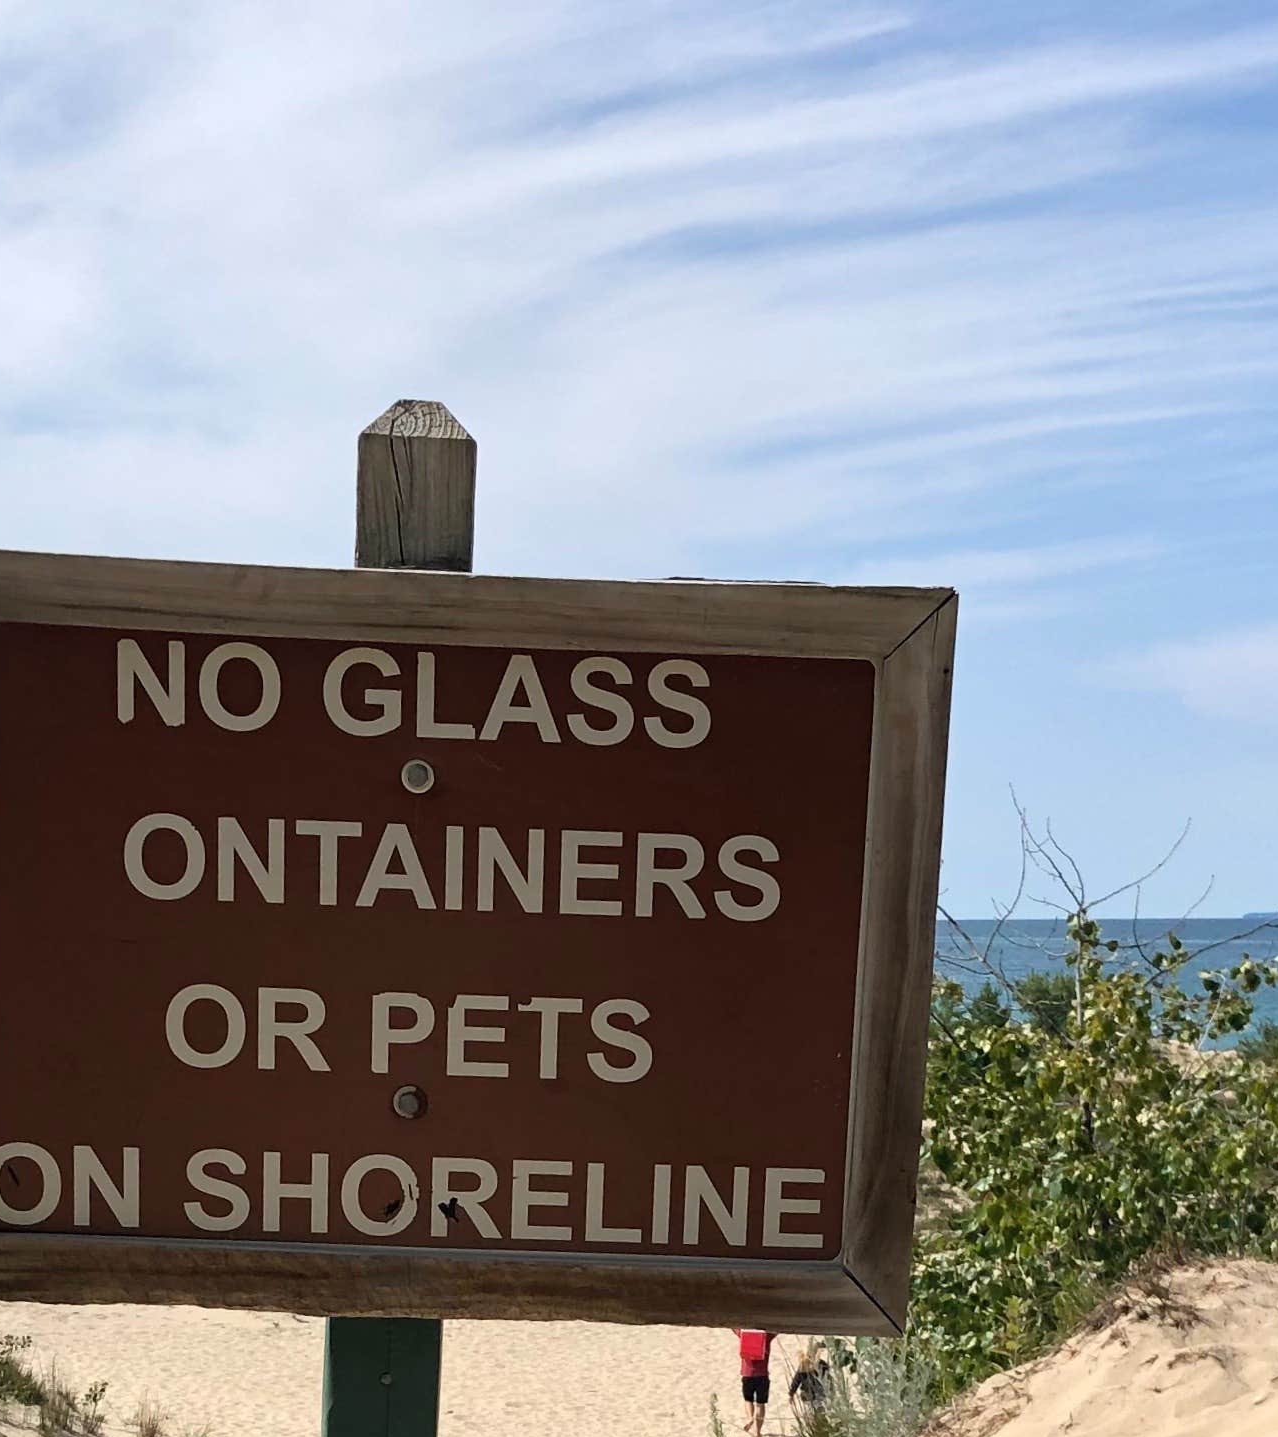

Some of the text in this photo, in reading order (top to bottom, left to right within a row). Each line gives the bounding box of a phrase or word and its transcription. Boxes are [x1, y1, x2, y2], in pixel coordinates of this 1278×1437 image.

[117, 639, 711, 749] NO GLASS
[124, 813, 781, 922] ONTAINERS
[165, 983, 653, 1083] OR PETS
[183, 1148, 826, 1248] SHORELINE
